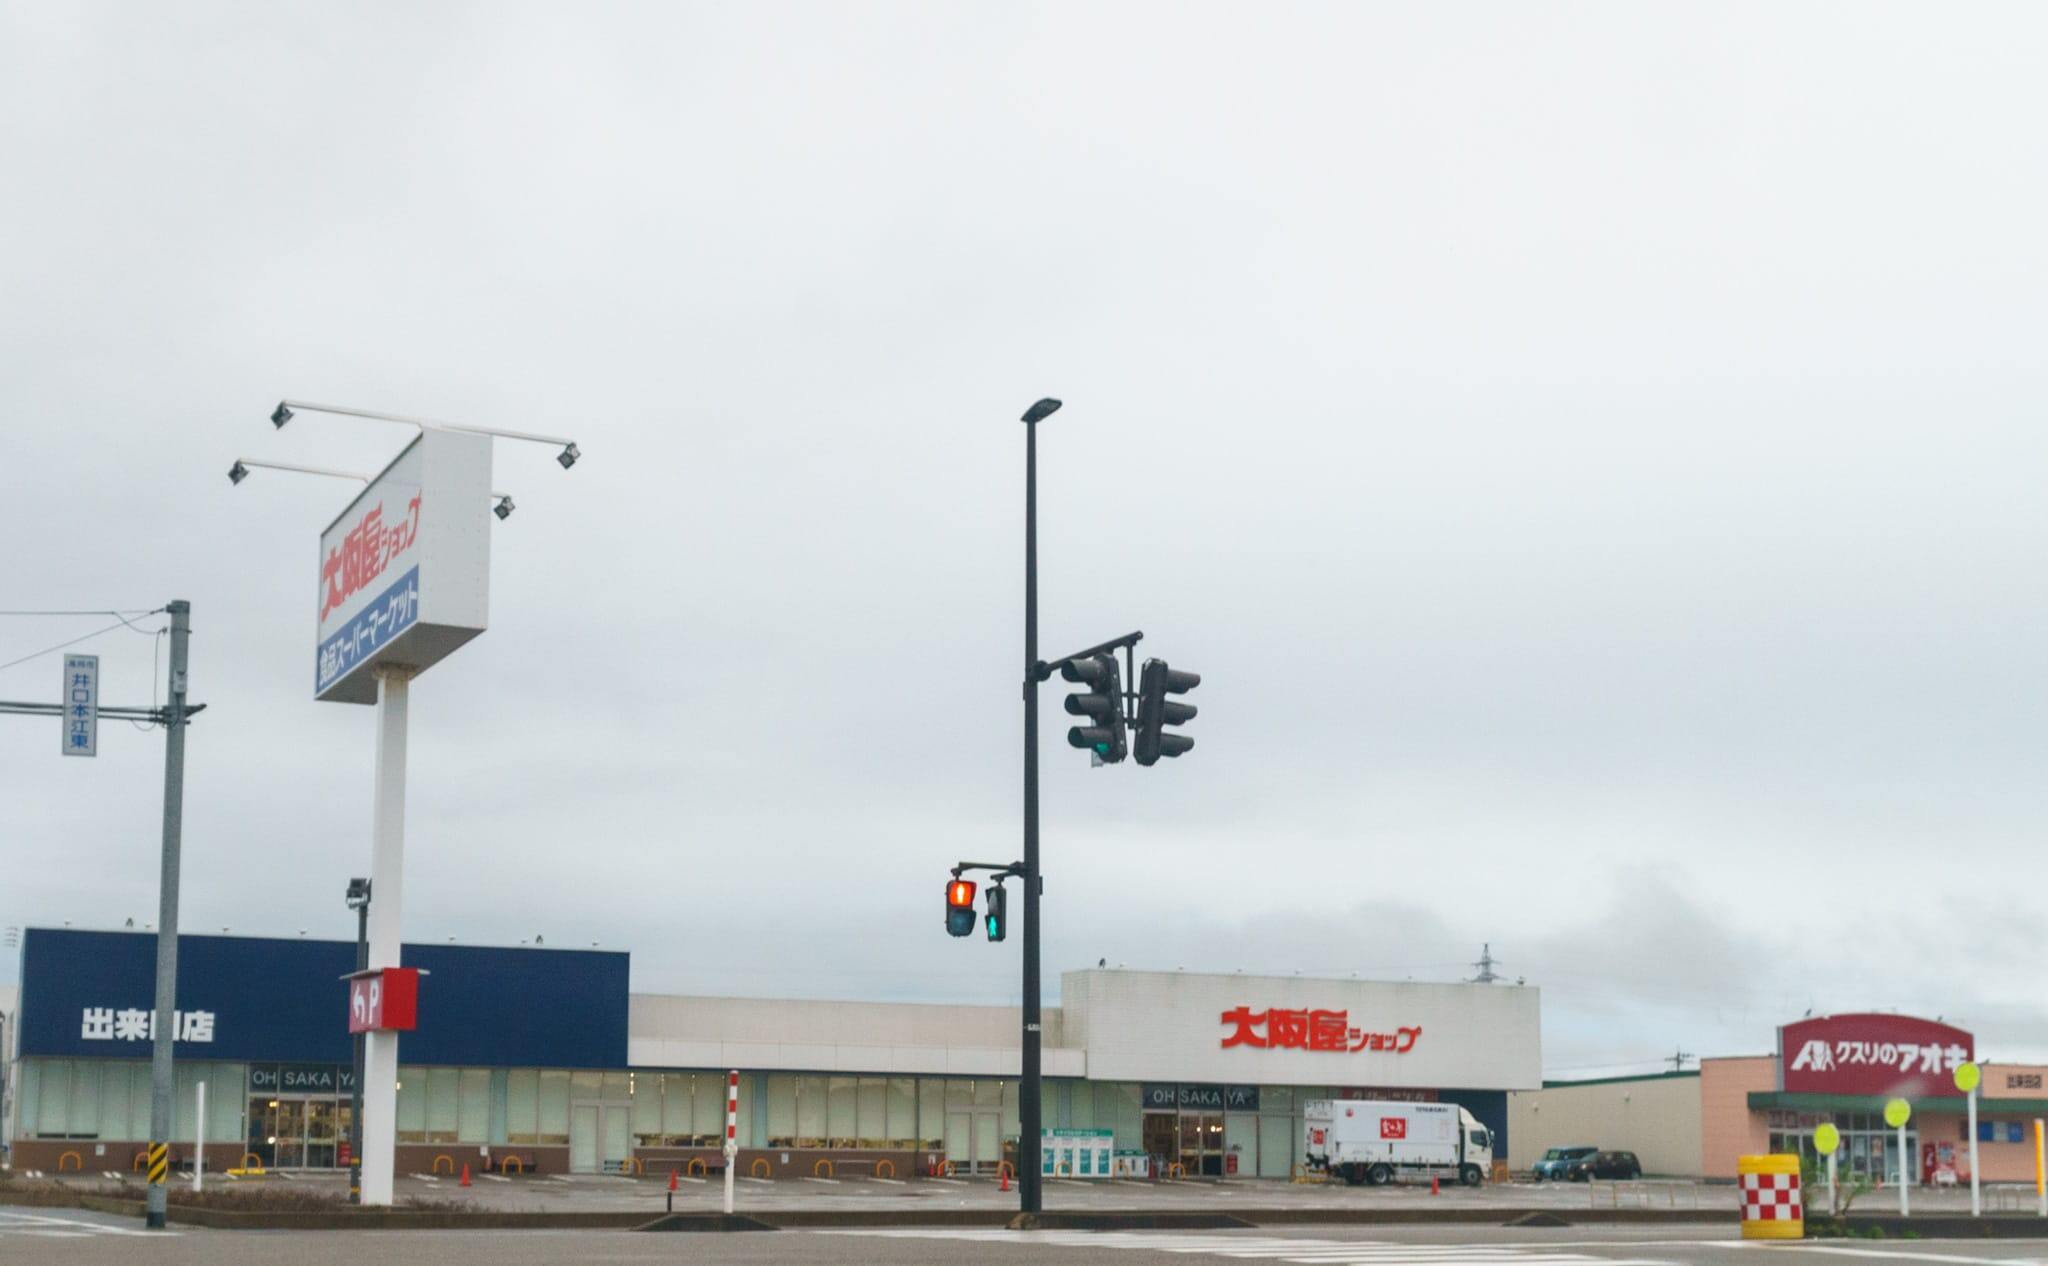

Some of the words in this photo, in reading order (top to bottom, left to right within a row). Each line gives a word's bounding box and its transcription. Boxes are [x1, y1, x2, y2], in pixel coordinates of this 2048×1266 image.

[321, 489, 421, 623] 大阪屋ショップ
[320, 581, 418, 686] 食品スーパーマーケット
[70, 672, 90, 749] 井口本江東
[368, 978, 380, 1025] P
[1221, 1007, 1422, 1052] 大阪屋ショップ
[252, 1070, 277, 1086] OH
[284, 1070, 332, 1087] SAKA
[1836, 1040, 1968, 1075] クスリのアオキ
[1153, 1089, 1175, 1104] OH
[1180, 1090, 1222, 1105] SAKA
[1227, 1091, 1246, 1105] YA
